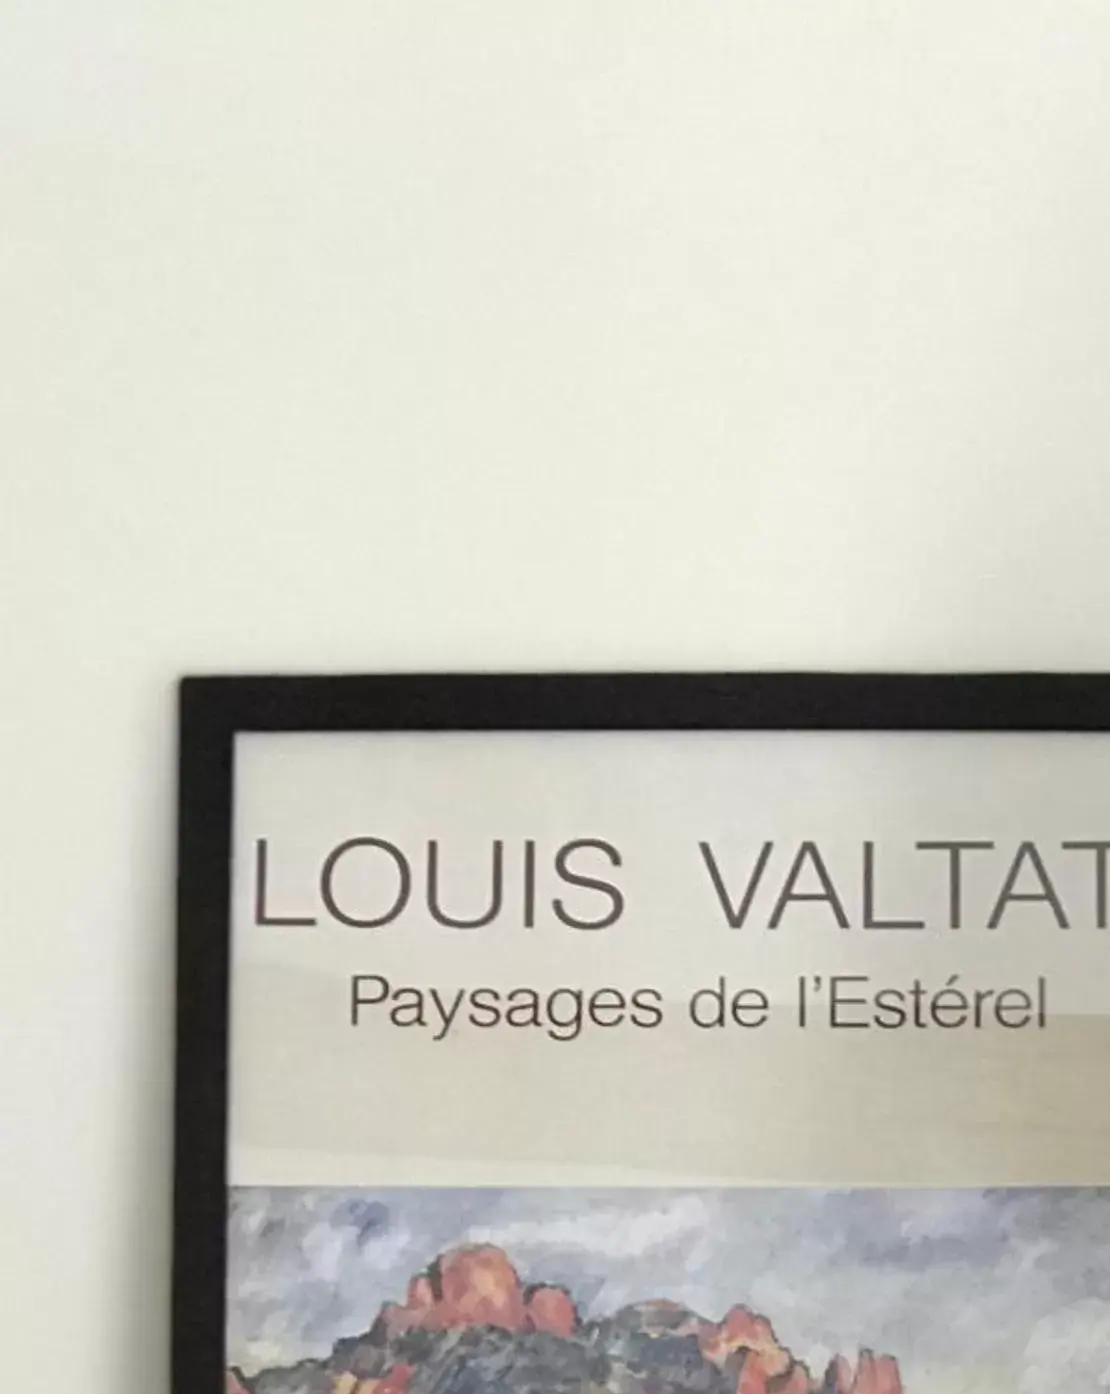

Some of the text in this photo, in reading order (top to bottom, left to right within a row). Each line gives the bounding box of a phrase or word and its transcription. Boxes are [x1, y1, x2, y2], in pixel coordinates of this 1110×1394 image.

[253, 836, 626, 932] LOUIS
[349, 973, 665, 1042] Paysages
[687, 974, 771, 1029] de
